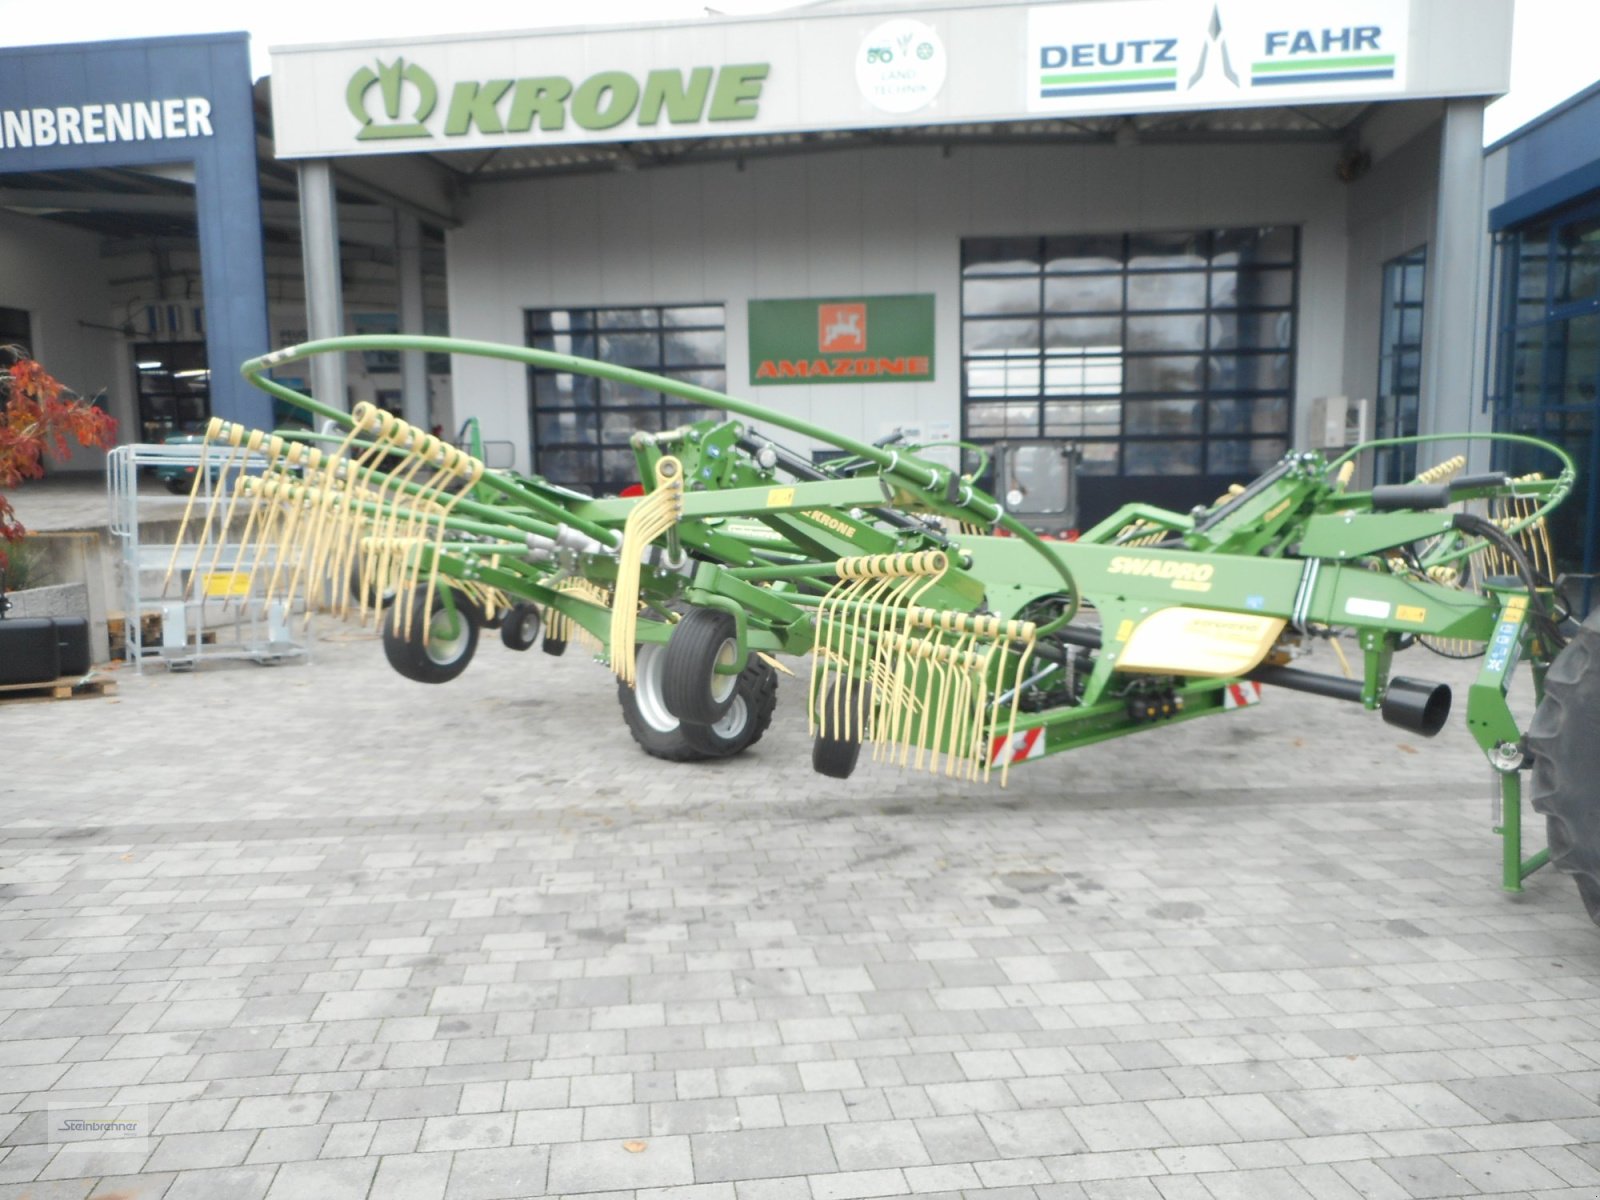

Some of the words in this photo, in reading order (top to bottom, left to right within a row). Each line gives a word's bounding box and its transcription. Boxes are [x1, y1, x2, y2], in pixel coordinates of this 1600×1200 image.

[1040, 38, 1178, 69] DEUTZ
[1265, 26, 1382, 56] FAHR
[444, 62, 770, 136] KRONE
[755, 356, 929, 379] AMAZONE
[811, 510, 856, 538] KRONE
[1107, 556, 1214, 581] SWADRO
